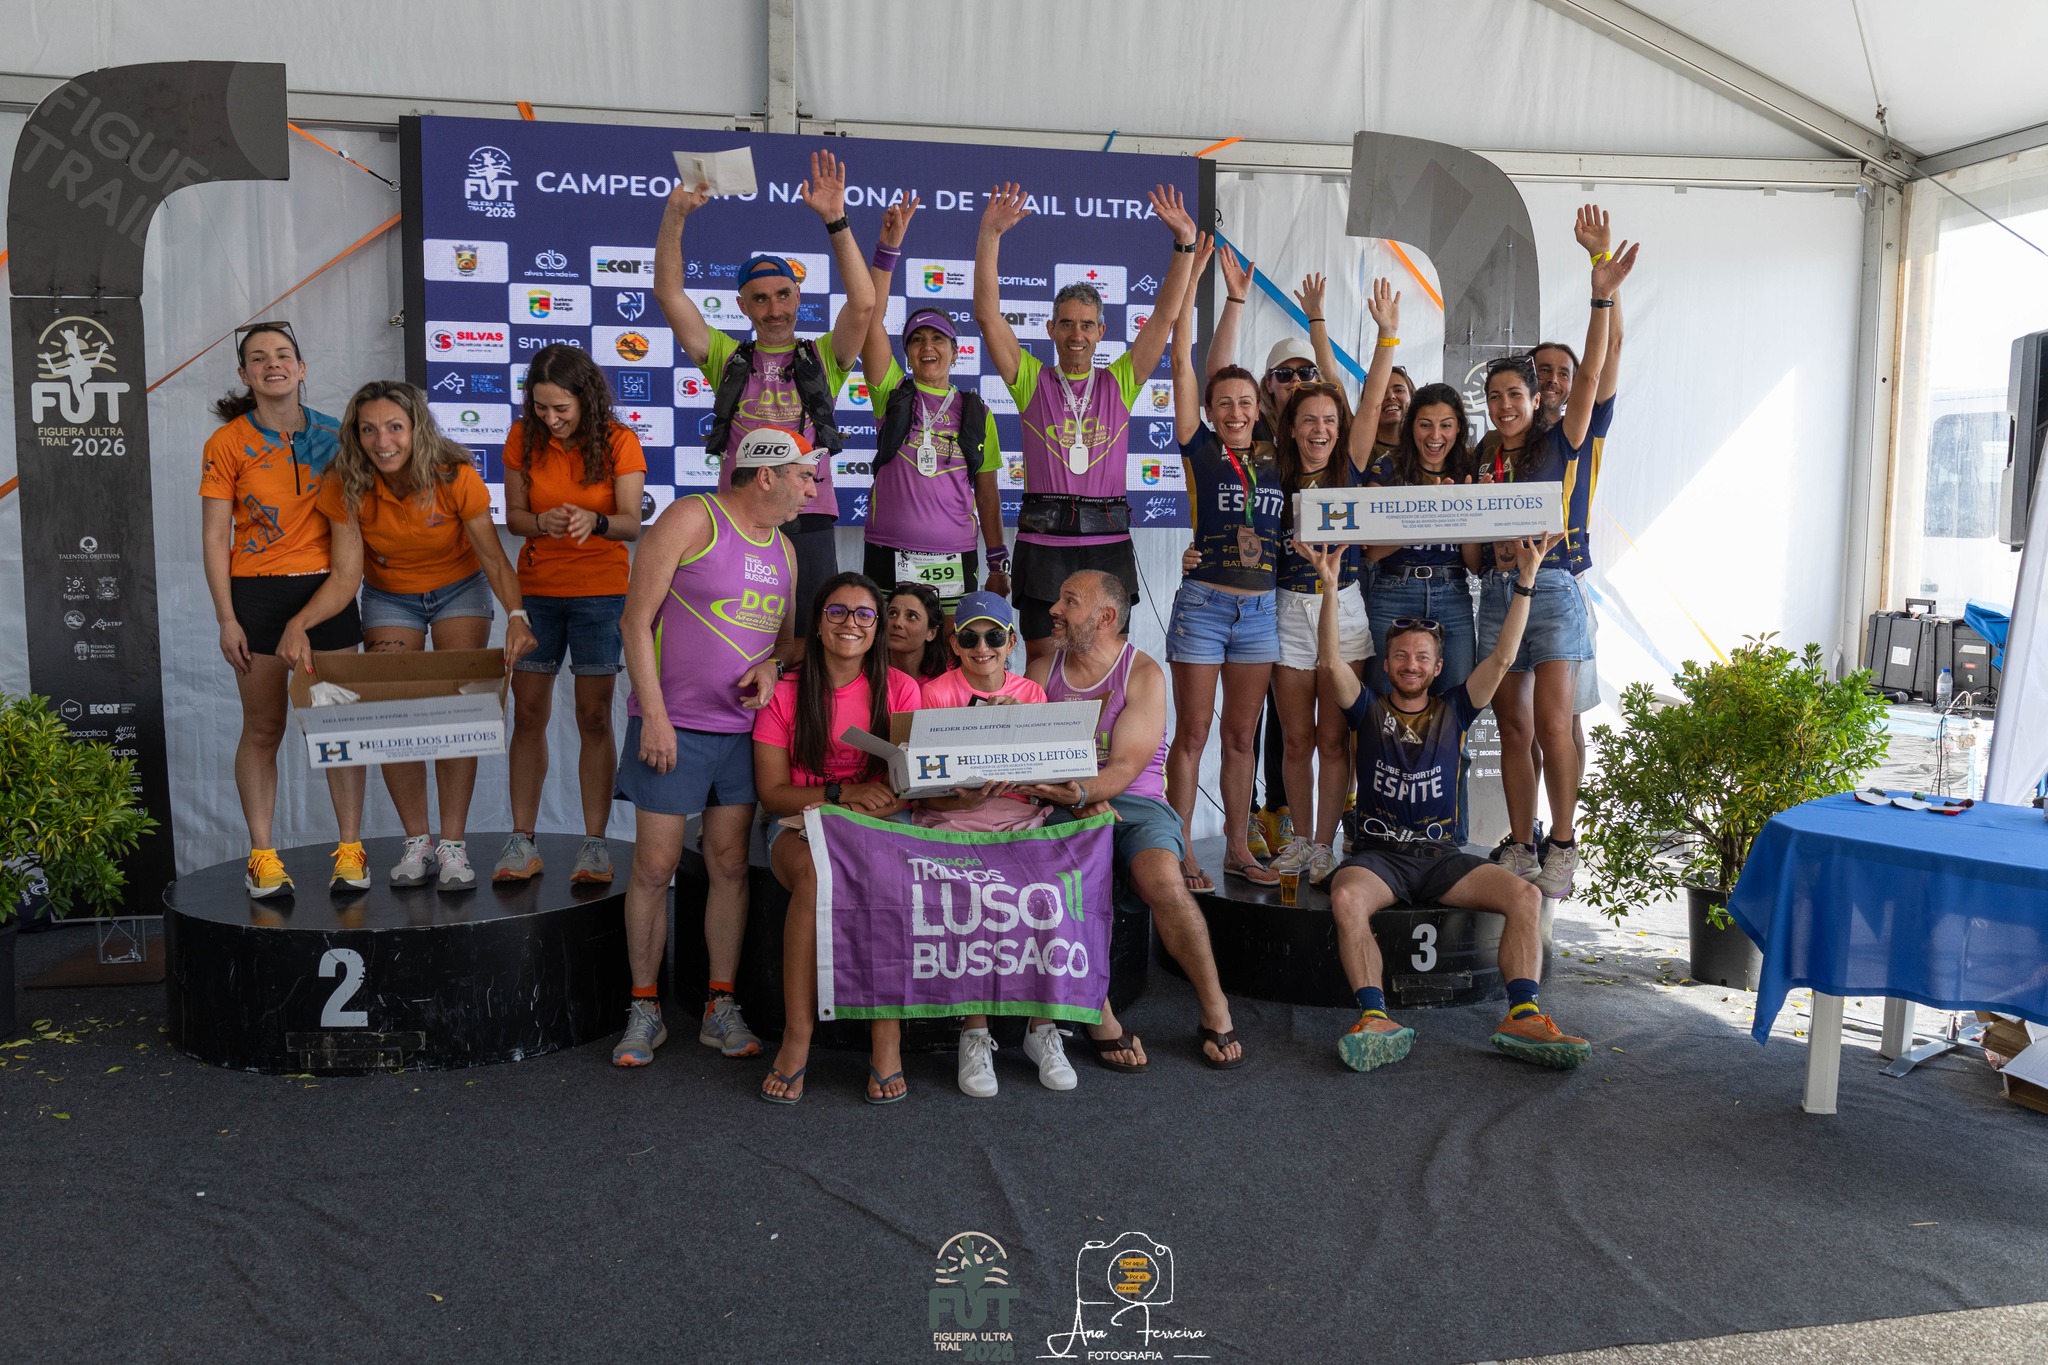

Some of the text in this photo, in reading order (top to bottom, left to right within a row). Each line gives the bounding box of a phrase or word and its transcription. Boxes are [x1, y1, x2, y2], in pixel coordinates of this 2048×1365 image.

[41, 80, 215, 196] FIGUE
[465, 178, 519, 201] FUT
[536, 171, 757, 201] CAMPEO
[769, 182, 926, 210] NAONAL
[936, 190, 974, 211] DE
[982, 192, 1065, 215] AIL
[485, 207, 516, 218] 2026
[710, 263, 741, 271] figueir
[998, 276, 1047, 286] ECATHLON
[457, 331, 504, 342] SILVAS
[623, 384, 644, 393] SOL
[31, 382, 130, 424] FUT
[38, 427, 124, 437] FIGUEIRA ULTRA
[838, 425, 877, 435] DECATH
[39, 437, 69, 447] TRAIL
[71, 438, 126, 456] 2026
[1218, 483, 1244, 491] CLUB
[1370, 495, 1543, 514] HELDER DOS LEITÕES
[1143, 507, 1176, 522] XOPA
[1317, 501, 1360, 530] H
[744, 564, 771, 576] LUSO
[744, 572, 779, 586] BUSSACO
[920, 567, 954, 581] 459
[1481, 719, 1498, 727] snup
[359, 730, 497, 749] HELDER DOS LEITÕES
[110, 748, 138, 757] nupe.
[315, 740, 352, 763] H
[957, 748, 1088, 766] HELDER DOS LEITÕES
[916, 755, 950, 780] H
[1376, 759, 1400, 777] CLUBE
[1373, 771, 1443, 803] ESPITE
[907, 858, 1006, 882] TRILHOS
[911, 882, 1064, 936] LUSO
[1410, 923, 1438, 972] 3
[912, 936, 1089, 979] BUSSACO
[318, 948, 368, 1027] 2
